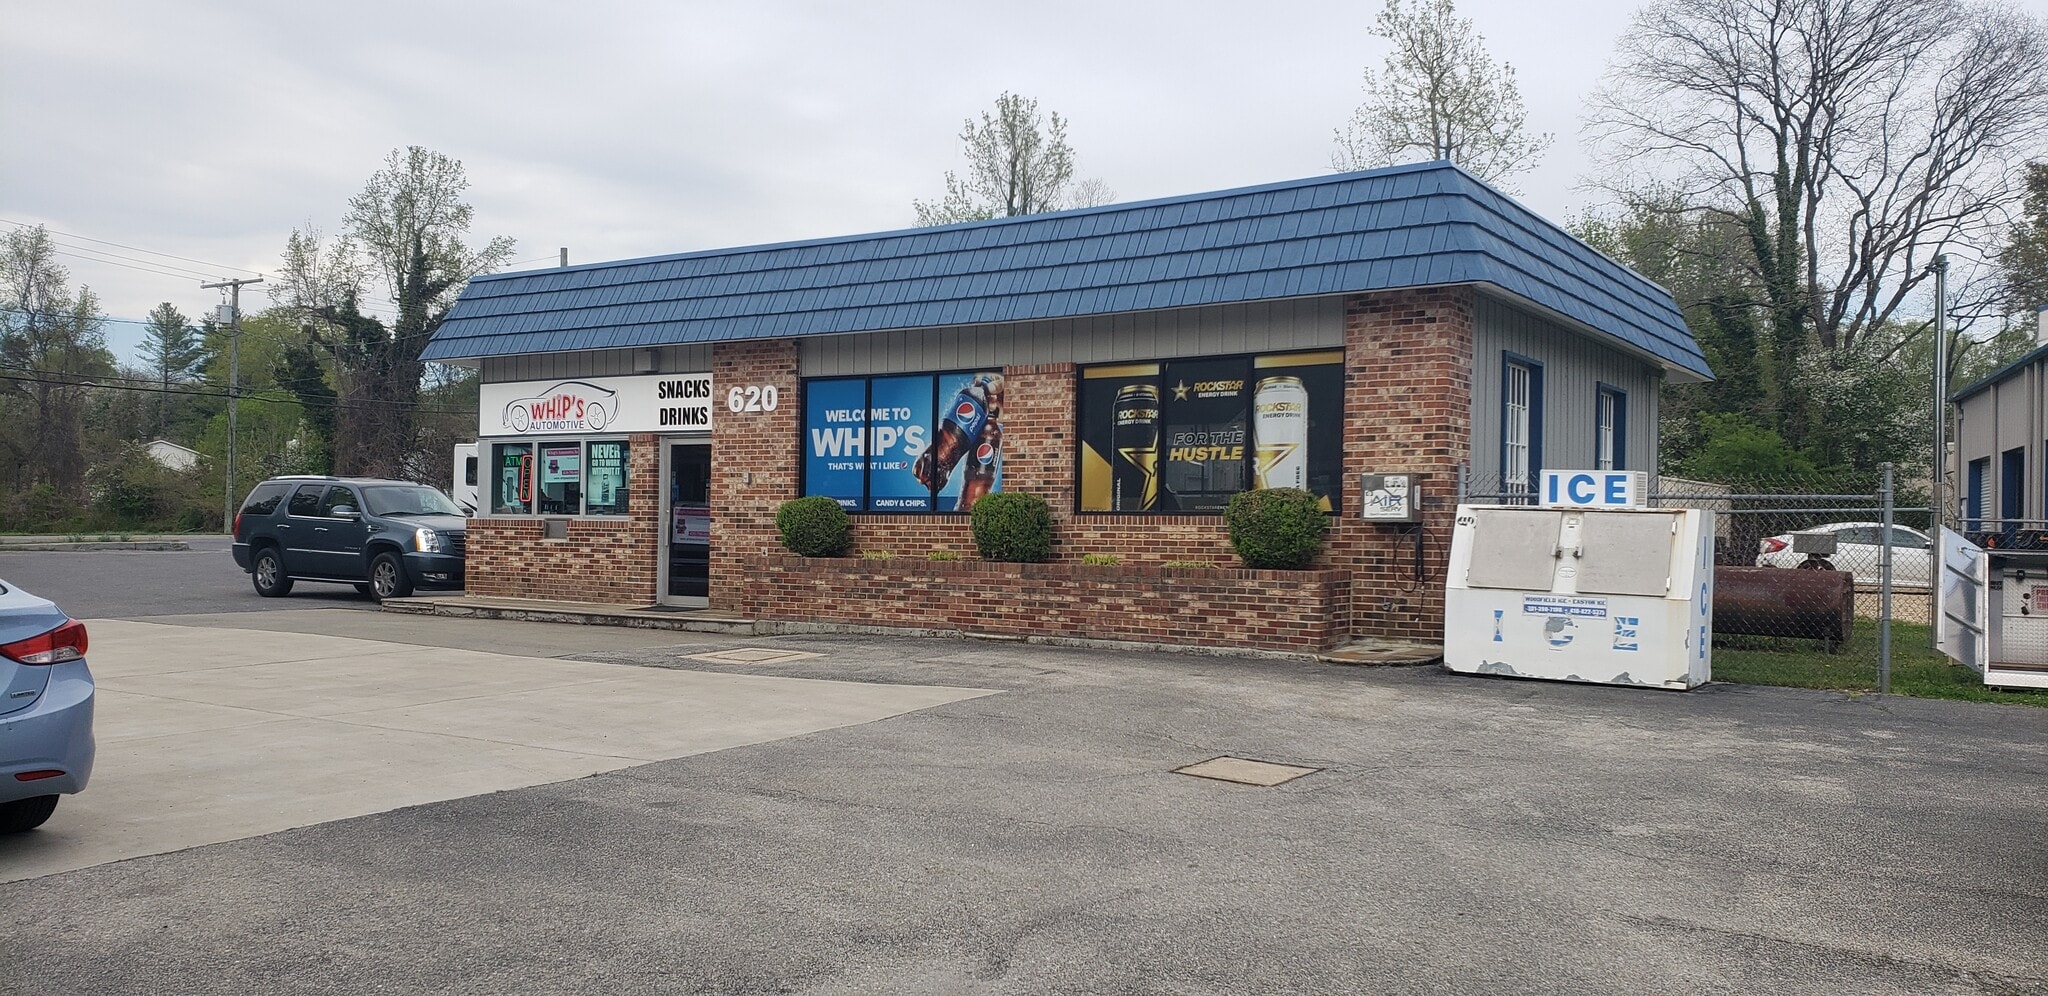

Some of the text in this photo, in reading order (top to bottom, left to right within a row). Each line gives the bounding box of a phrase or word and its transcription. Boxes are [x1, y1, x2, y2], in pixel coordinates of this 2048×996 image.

[658, 379, 710, 399] SNACKS
[1193, 380, 1244, 392] ROCKSTAR
[530, 393, 585, 420] WHIP'S
[728, 385, 778, 413] 620
[659, 406, 708, 426] DRINKS
[892, 407, 911, 421] TO
[1117, 408, 1159, 421] ROCKSTAR
[1255, 402, 1303, 414] ROCKSTAR
[530, 420, 584, 430] AUTOMOTIVE
[811, 425, 925, 457] WHIP'S
[1173, 430, 1245, 446] FOR THE
[591, 444, 620, 459] NEVER
[1169, 446, 1244, 462] HUSTLE
[828, 462, 854, 471] THAT'S
[883, 461, 900, 470] LIKE
[522, 457, 532, 499] OPEN
[1548, 474, 1627, 504] ICE
